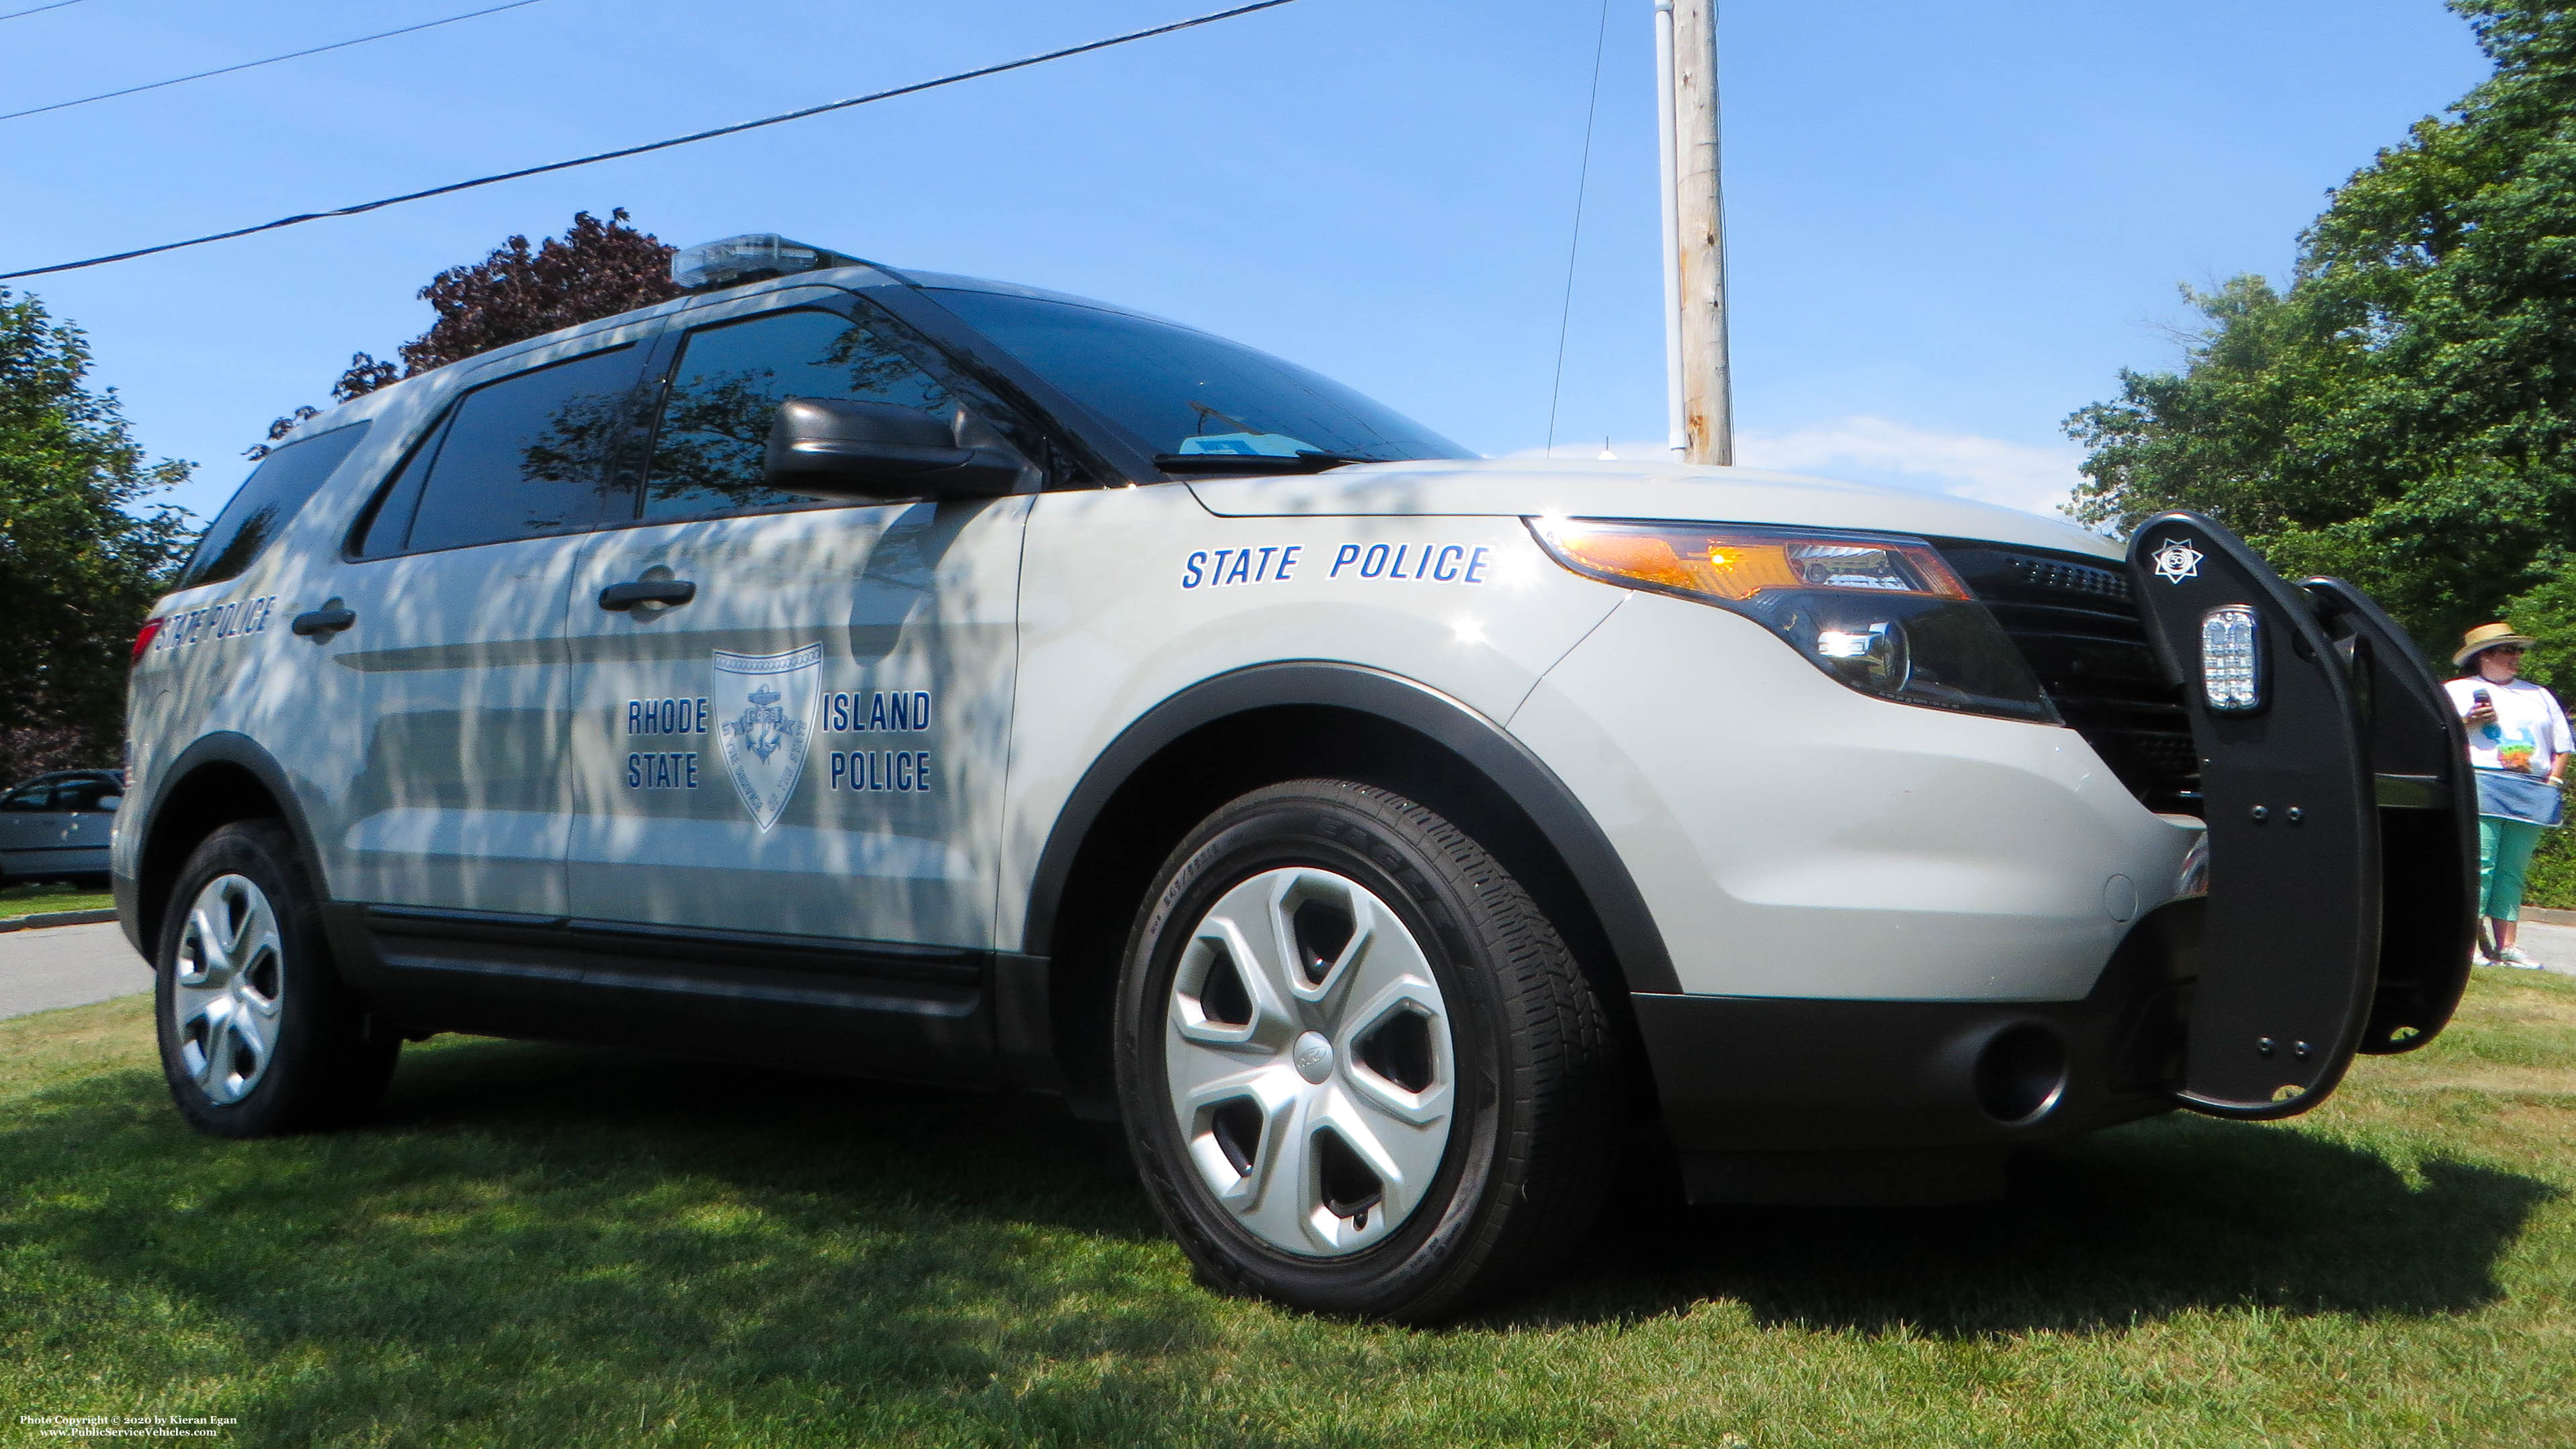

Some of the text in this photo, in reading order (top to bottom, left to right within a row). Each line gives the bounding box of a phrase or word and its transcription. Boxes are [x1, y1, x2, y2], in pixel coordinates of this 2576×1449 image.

[1183, 543, 1490, 589] STATE POLICE
[628, 691, 932, 734] RHODE ISLAND
[628, 752, 699, 789] STATE
[830, 751, 931, 791] POLICE
